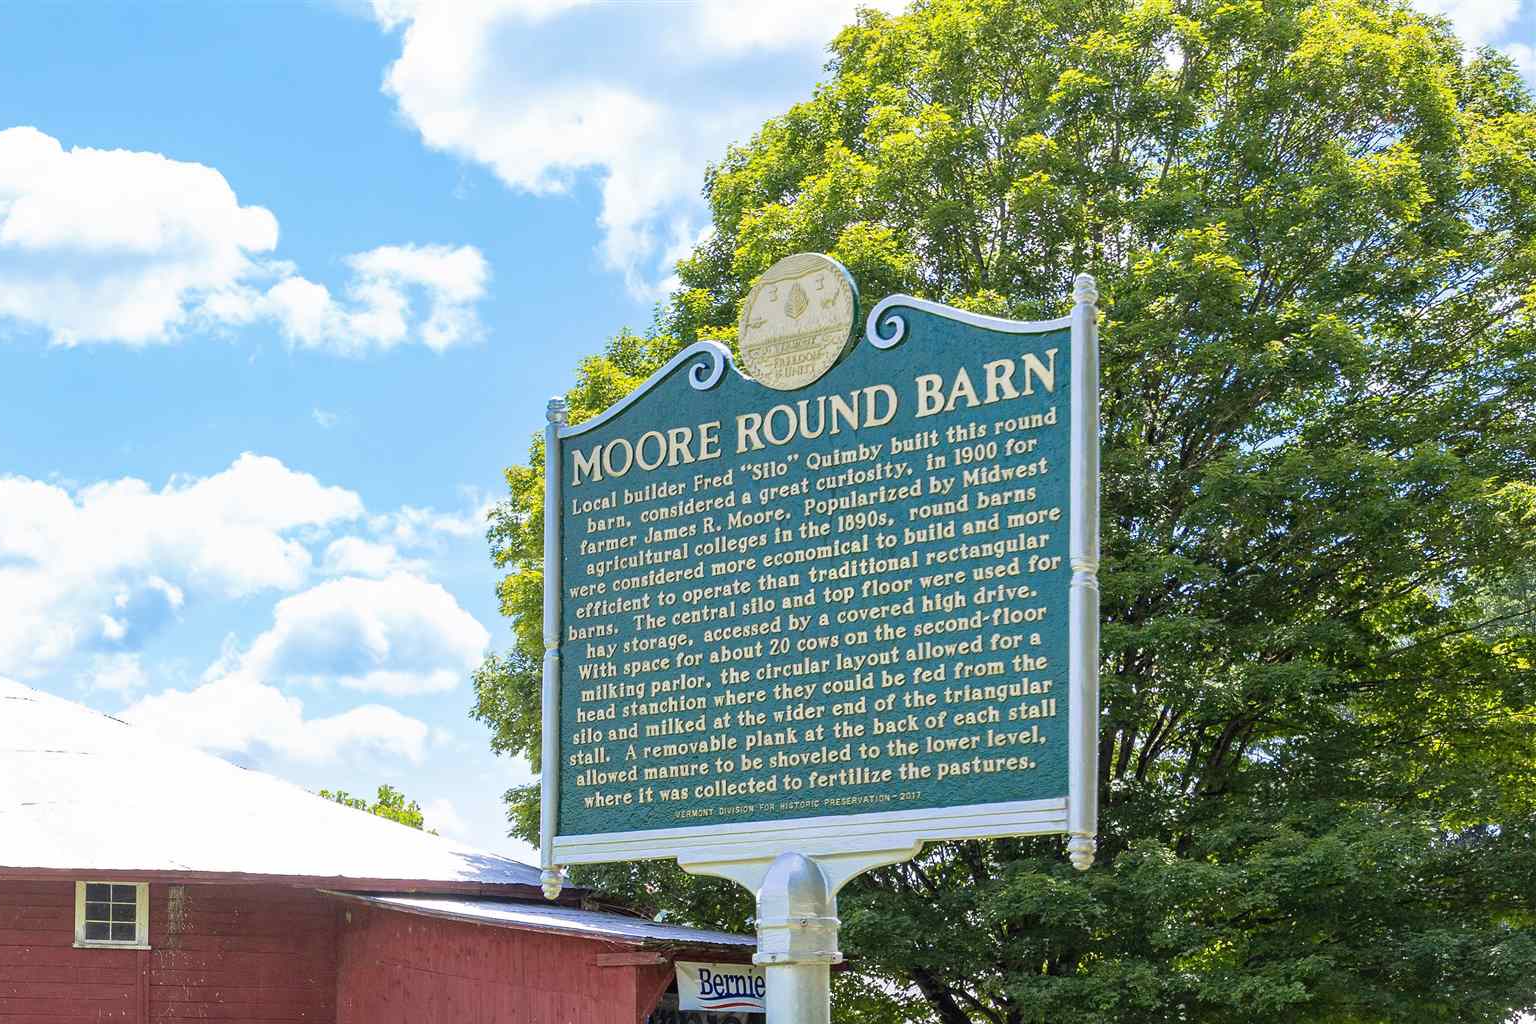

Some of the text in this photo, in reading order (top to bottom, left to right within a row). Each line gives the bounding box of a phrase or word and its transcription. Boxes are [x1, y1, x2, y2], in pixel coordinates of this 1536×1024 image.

[572, 348, 1058, 486] MOORE ROUND BARN
[572, 491, 617, 515] Local
[623, 481, 686, 505] builder
[694, 469, 733, 492] Fred
[806, 444, 883, 470] Quimby
[890, 430, 939, 455] built
[946, 422, 987, 443] this
[994, 406, 1057, 435] round
[640, 490, 736, 523] considered
[741, 492, 752, 505] a
[759, 478, 809, 505] great
[926, 453, 946, 471] in
[954, 441, 997, 465] 1900
[1005, 438, 1037, 456] for
[580, 457, 1048, 556] farmer James R. Moore. Popularized by Midwest
[586, 542, 688, 577] agricultural
[694, 534, 767, 557] colleges
[774, 527, 793, 544] in
[799, 521, 830, 539] the
[910, 494, 969, 521] round
[977, 487, 1036, 509] barns
[569, 507, 1061, 598] were considered more economical to build and more
[576, 533, 1050, 619] efficient to operate than traditional rectangular
[568, 555, 1061, 641] barns. The central silo and top floor were used for
[586, 643, 617, 659] hay
[703, 615, 781, 643] accessed
[788, 614, 812, 631] by
[818, 613, 830, 626] a
[837, 596, 914, 624] covered
[922, 591, 966, 613] high
[973, 584, 1037, 605] drive.
[578, 607, 1047, 680] With space for about 20 cows on the second-floor
[581, 682, 645, 702] milking
[720, 667, 750, 685] the
[756, 657, 830, 680] circular
[836, 646, 899, 671] layout
[906, 635, 983, 662] allowed
[990, 633, 1023, 651] for
[1030, 633, 1041, 645] a
[573, 677, 1052, 745] silo and milked at the wider end of the triangular
[576, 654, 1048, 723] head stanchion where they could be fed from the
[569, 698, 1056, 766] stall. A removable plank at the back of each stall
[576, 765, 638, 786] allowed
[644, 762, 709, 780] manure
[714, 757, 734, 773] to
[741, 754, 763, 771] be
[769, 743, 851, 768] shoveled
[858, 743, 880, 759] to
[886, 739, 919, 757] the
[926, 735, 980, 753] lower
[584, 756, 1035, 808] where it was collected to fertilize the pastures.
[698, 968, 766, 998] Bernie
